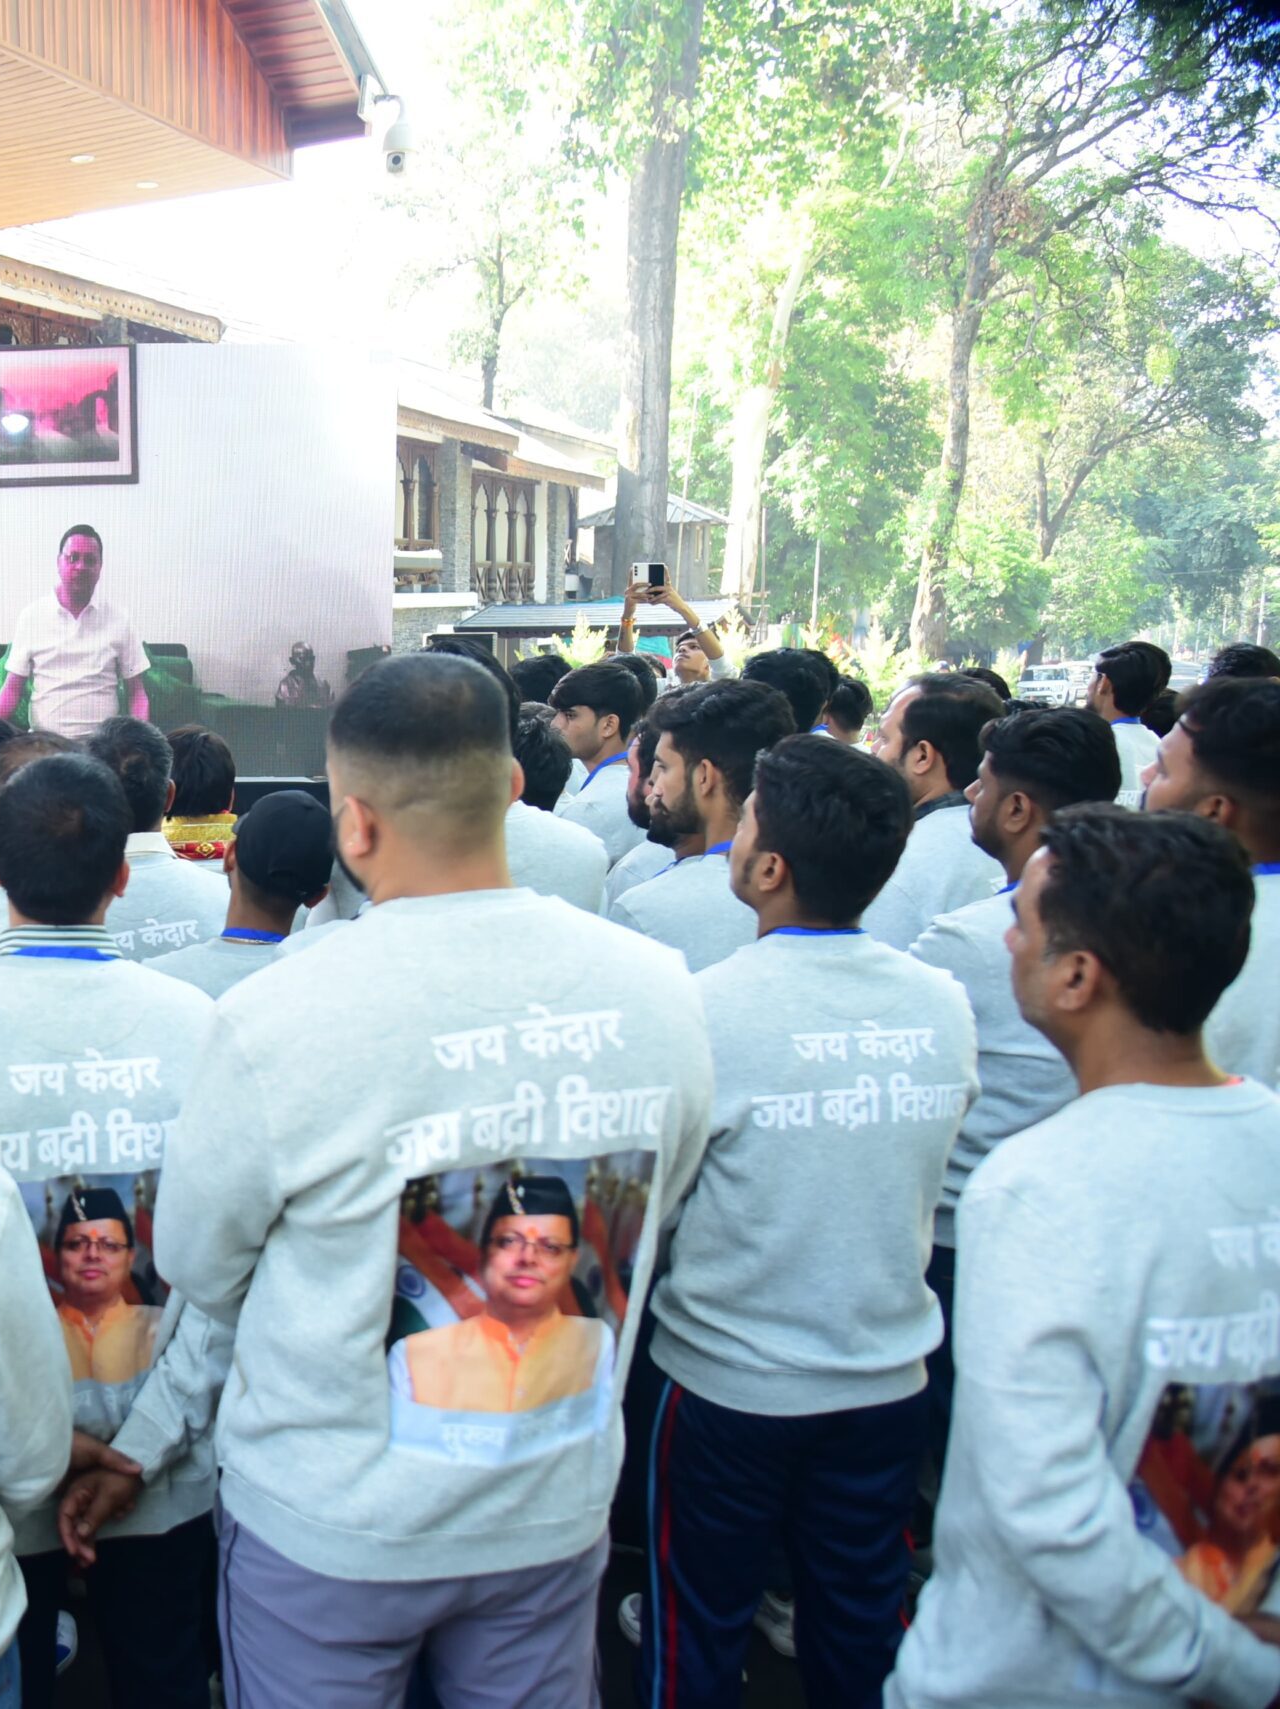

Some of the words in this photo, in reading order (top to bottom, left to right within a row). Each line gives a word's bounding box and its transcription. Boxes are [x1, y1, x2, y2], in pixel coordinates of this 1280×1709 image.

[138, 918, 200, 947] केदार
[430, 1024, 507, 1071] जय
[513, 1003, 626, 1062] केदार
[790, 1032, 848, 1062] जय
[851, 1019, 939, 1064] केदार
[7, 1062, 67, 1097] जय
[72, 1047, 161, 1099] केदार
[383, 1108, 464, 1168] जय
[469, 1080, 546, 1155] बद्री
[751, 1091, 815, 1130] जय
[821, 1074, 881, 1131] बद्री
[36, 1110, 98, 1170] बद्री
[105, 1108, 176, 1164] विश
